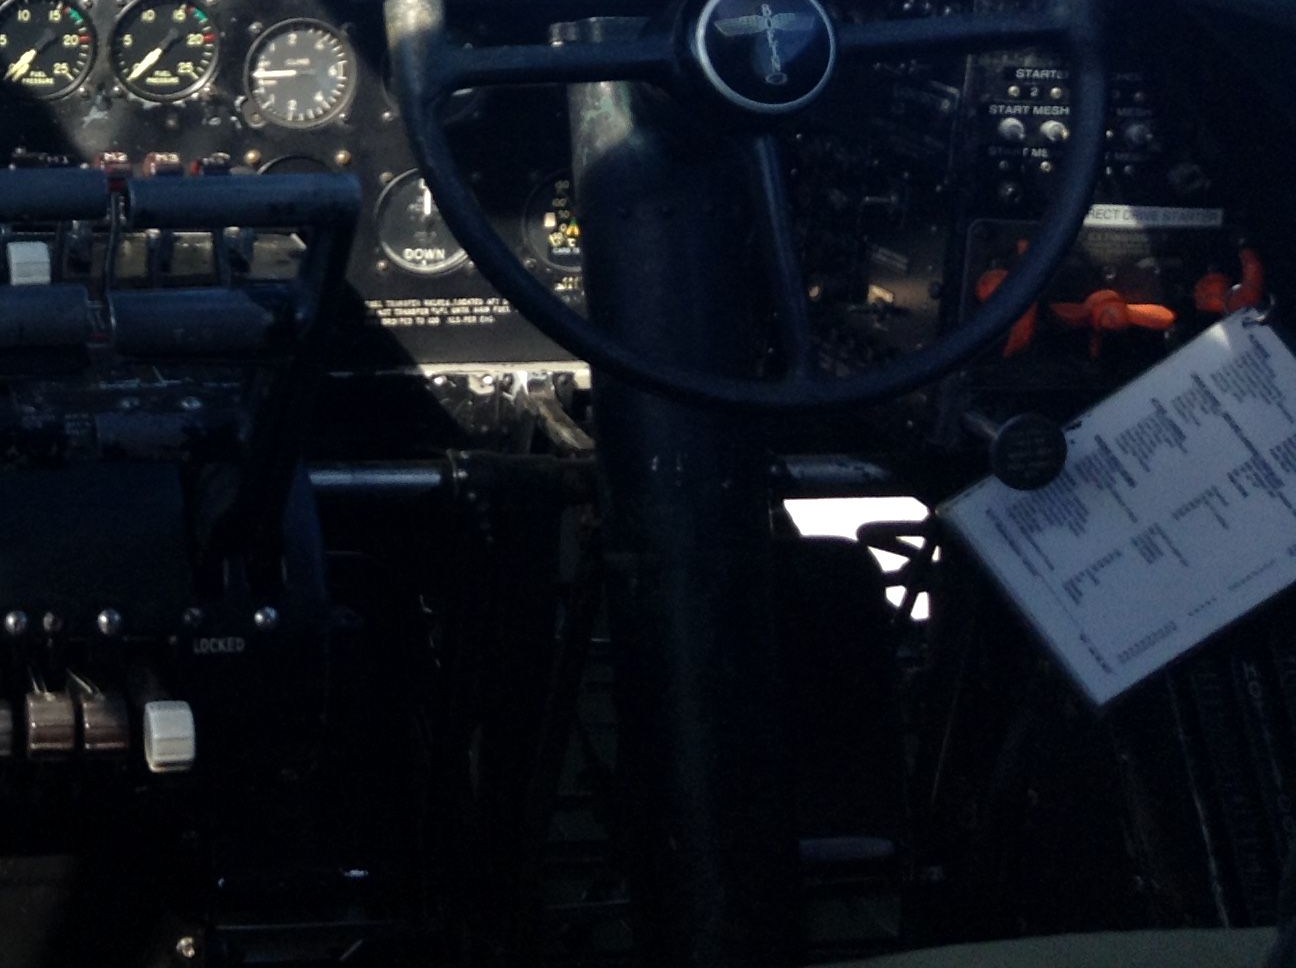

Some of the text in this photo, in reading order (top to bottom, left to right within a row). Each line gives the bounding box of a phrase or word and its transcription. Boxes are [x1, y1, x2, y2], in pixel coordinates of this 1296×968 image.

[16, 10, 32, 22] 10
[48, 10, 62, 22] 15
[140, 9, 156, 22] 10
[62, 34, 80, 46] 20
[122, 34, 133, 46] 5
[186, 34, 204, 46] 20
[52, 62, 70, 75] 25
[176, 62, 194, 74] 25
[988, 105, 1070, 116] START MESH
[402, 248, 446, 260] DOWN
[192, 636, 245, 653] LOCKED
